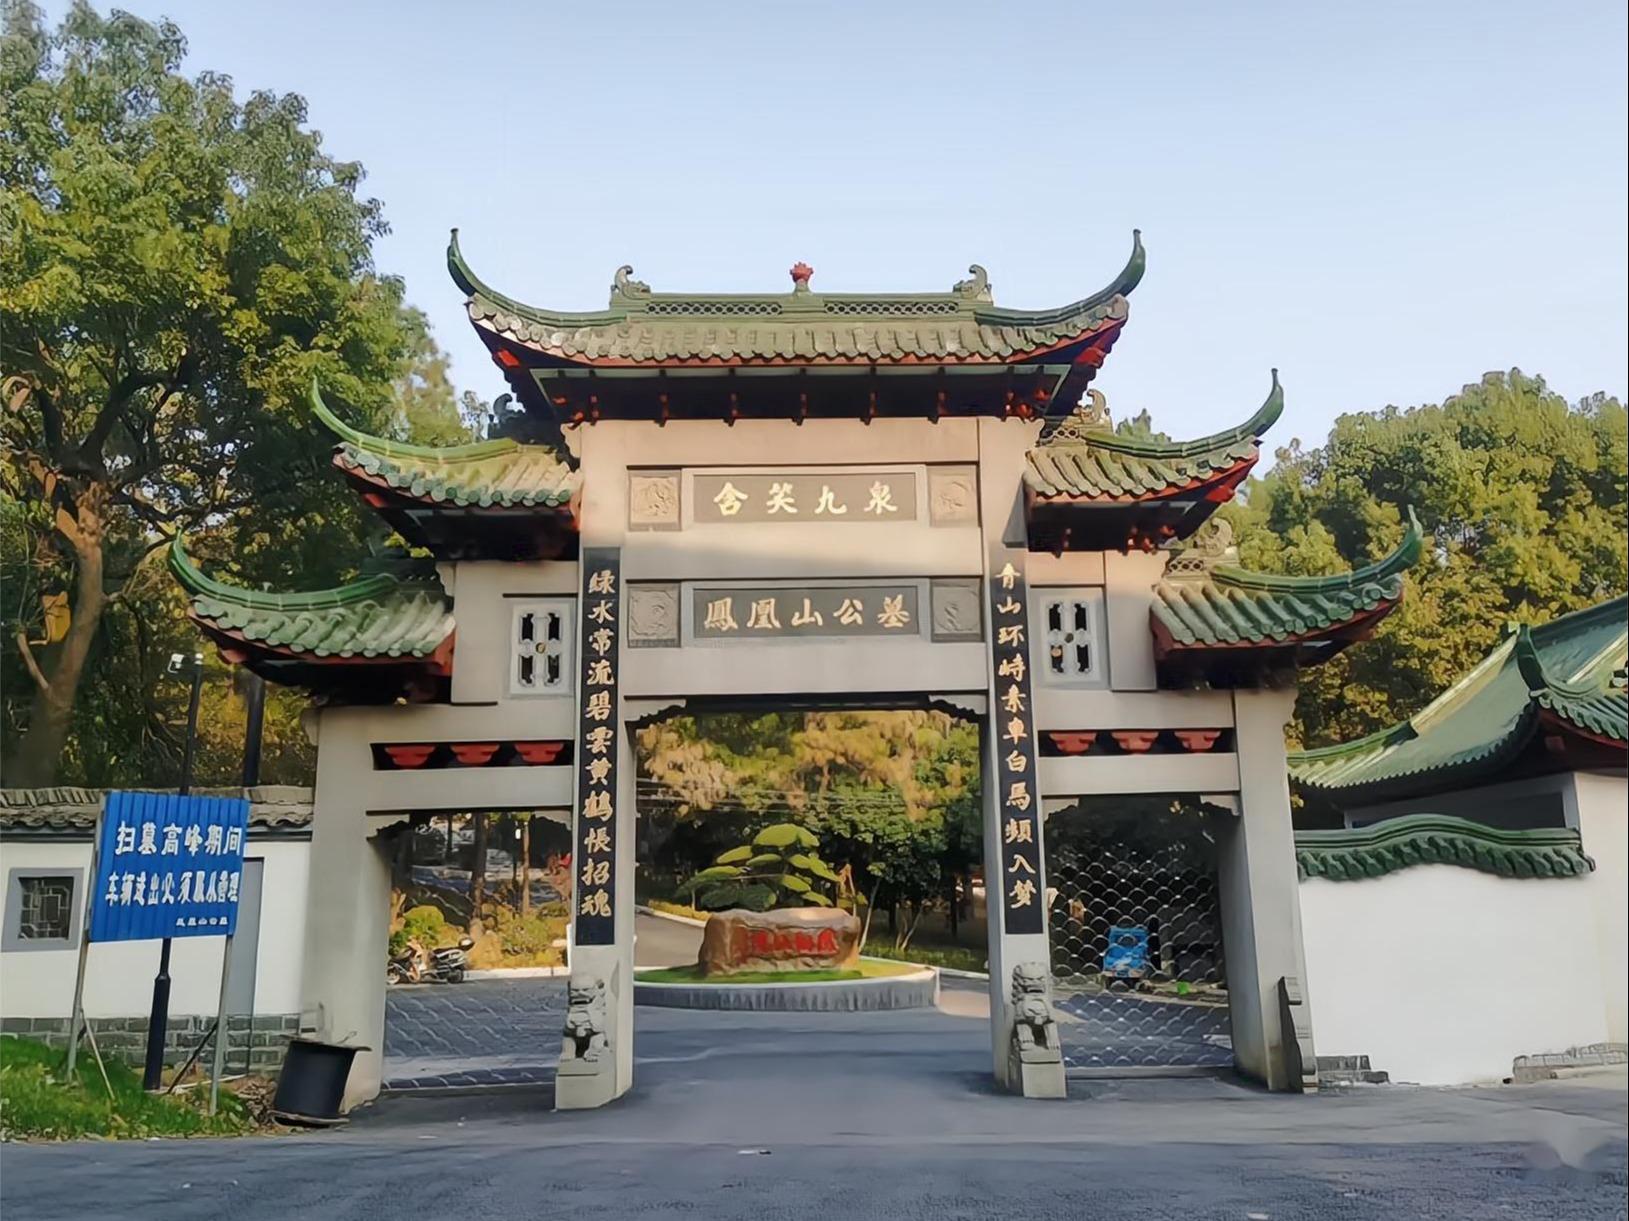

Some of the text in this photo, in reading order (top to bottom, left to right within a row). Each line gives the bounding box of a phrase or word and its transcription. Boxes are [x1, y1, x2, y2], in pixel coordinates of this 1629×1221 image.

[713, 480, 899, 516] 含笑九泉
[703, 594, 911, 632] 鳳凰山公墓
[115, 820, 243, 857] 扫墓高峰期间
